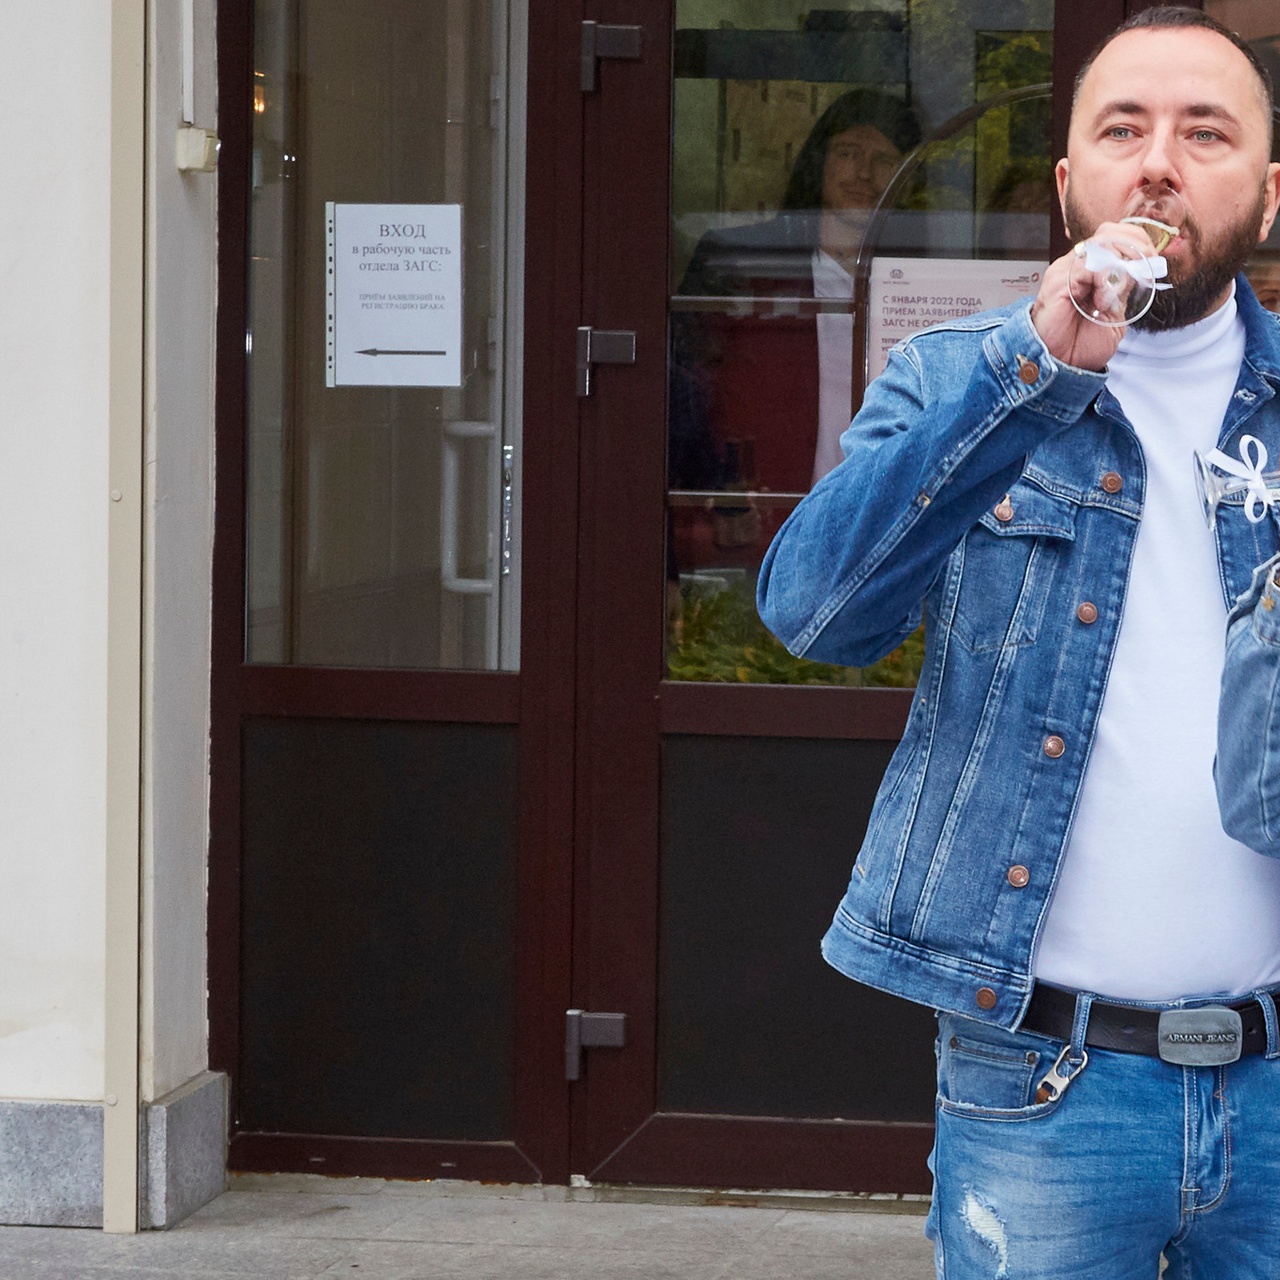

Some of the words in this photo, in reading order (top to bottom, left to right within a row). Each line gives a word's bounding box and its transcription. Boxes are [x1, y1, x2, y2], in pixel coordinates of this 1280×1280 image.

[380, 224, 426, 239] ВХОД
[352, 246, 359, 254] в
[362, 243, 415, 257] рабочую
[419, 246, 452, 255] часть
[359, 262, 400, 272] отдела
[403, 260, 442, 272] ЗАГС:
[882, 295, 888, 304] С
[891, 295, 928, 304] ЯНВАРЯ
[931, 296, 953, 305] 2022
[956, 297, 982, 307] ГОДА
[882, 319, 905, 328] ЗАГС
[907, 319, 920, 328] НЕ
[1167, 1033, 1203, 1043] ARMANI
[1206, 1033, 1235, 1043] JEANS
